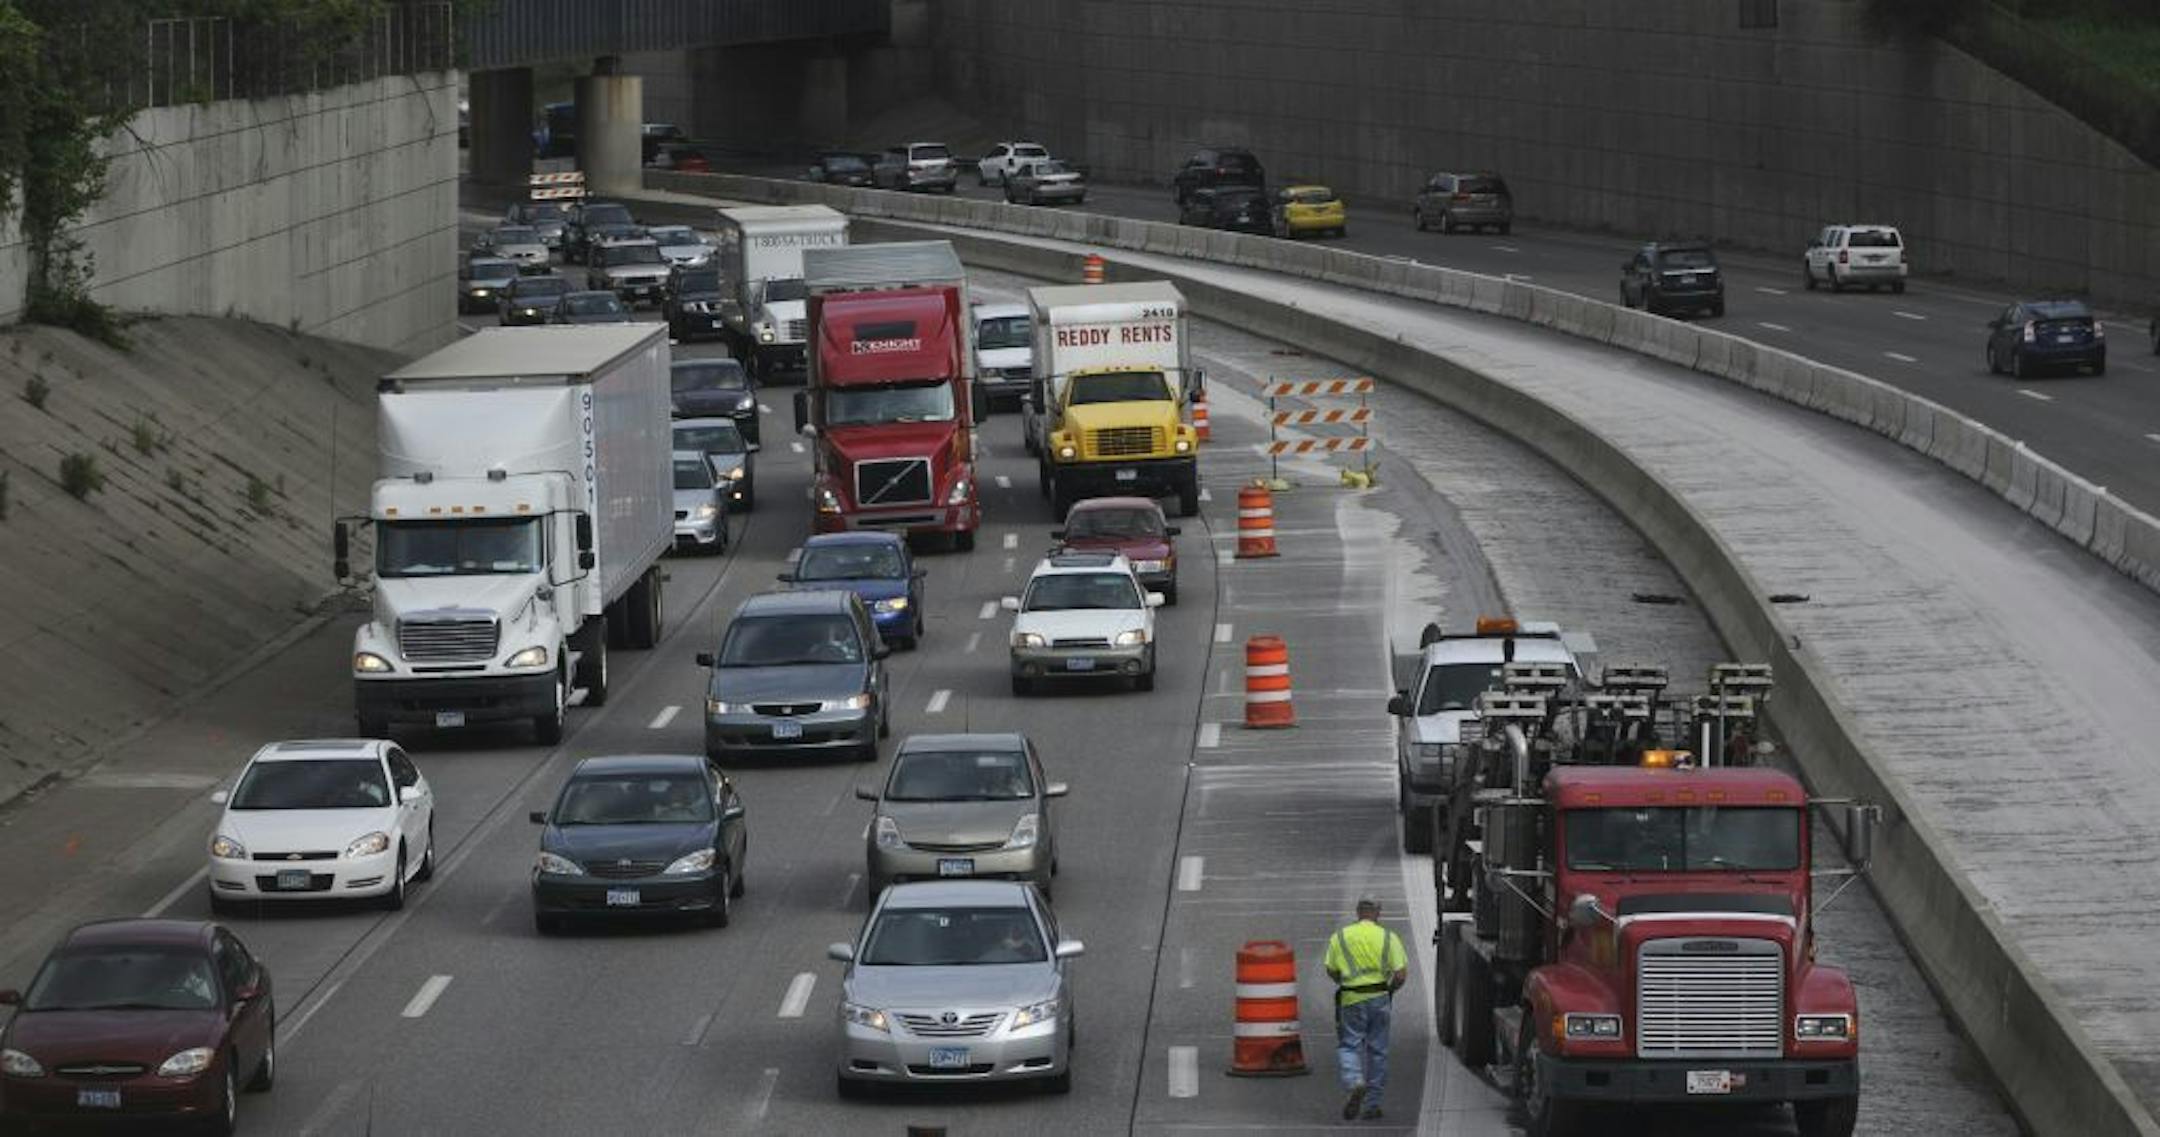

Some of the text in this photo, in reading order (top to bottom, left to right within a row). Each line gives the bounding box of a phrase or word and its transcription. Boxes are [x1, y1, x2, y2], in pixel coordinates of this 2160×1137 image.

[851, 339, 922, 355] KNIGHT
[1058, 324, 1172, 347] REDDY RENTS
[582, 393, 594, 504] 90501
